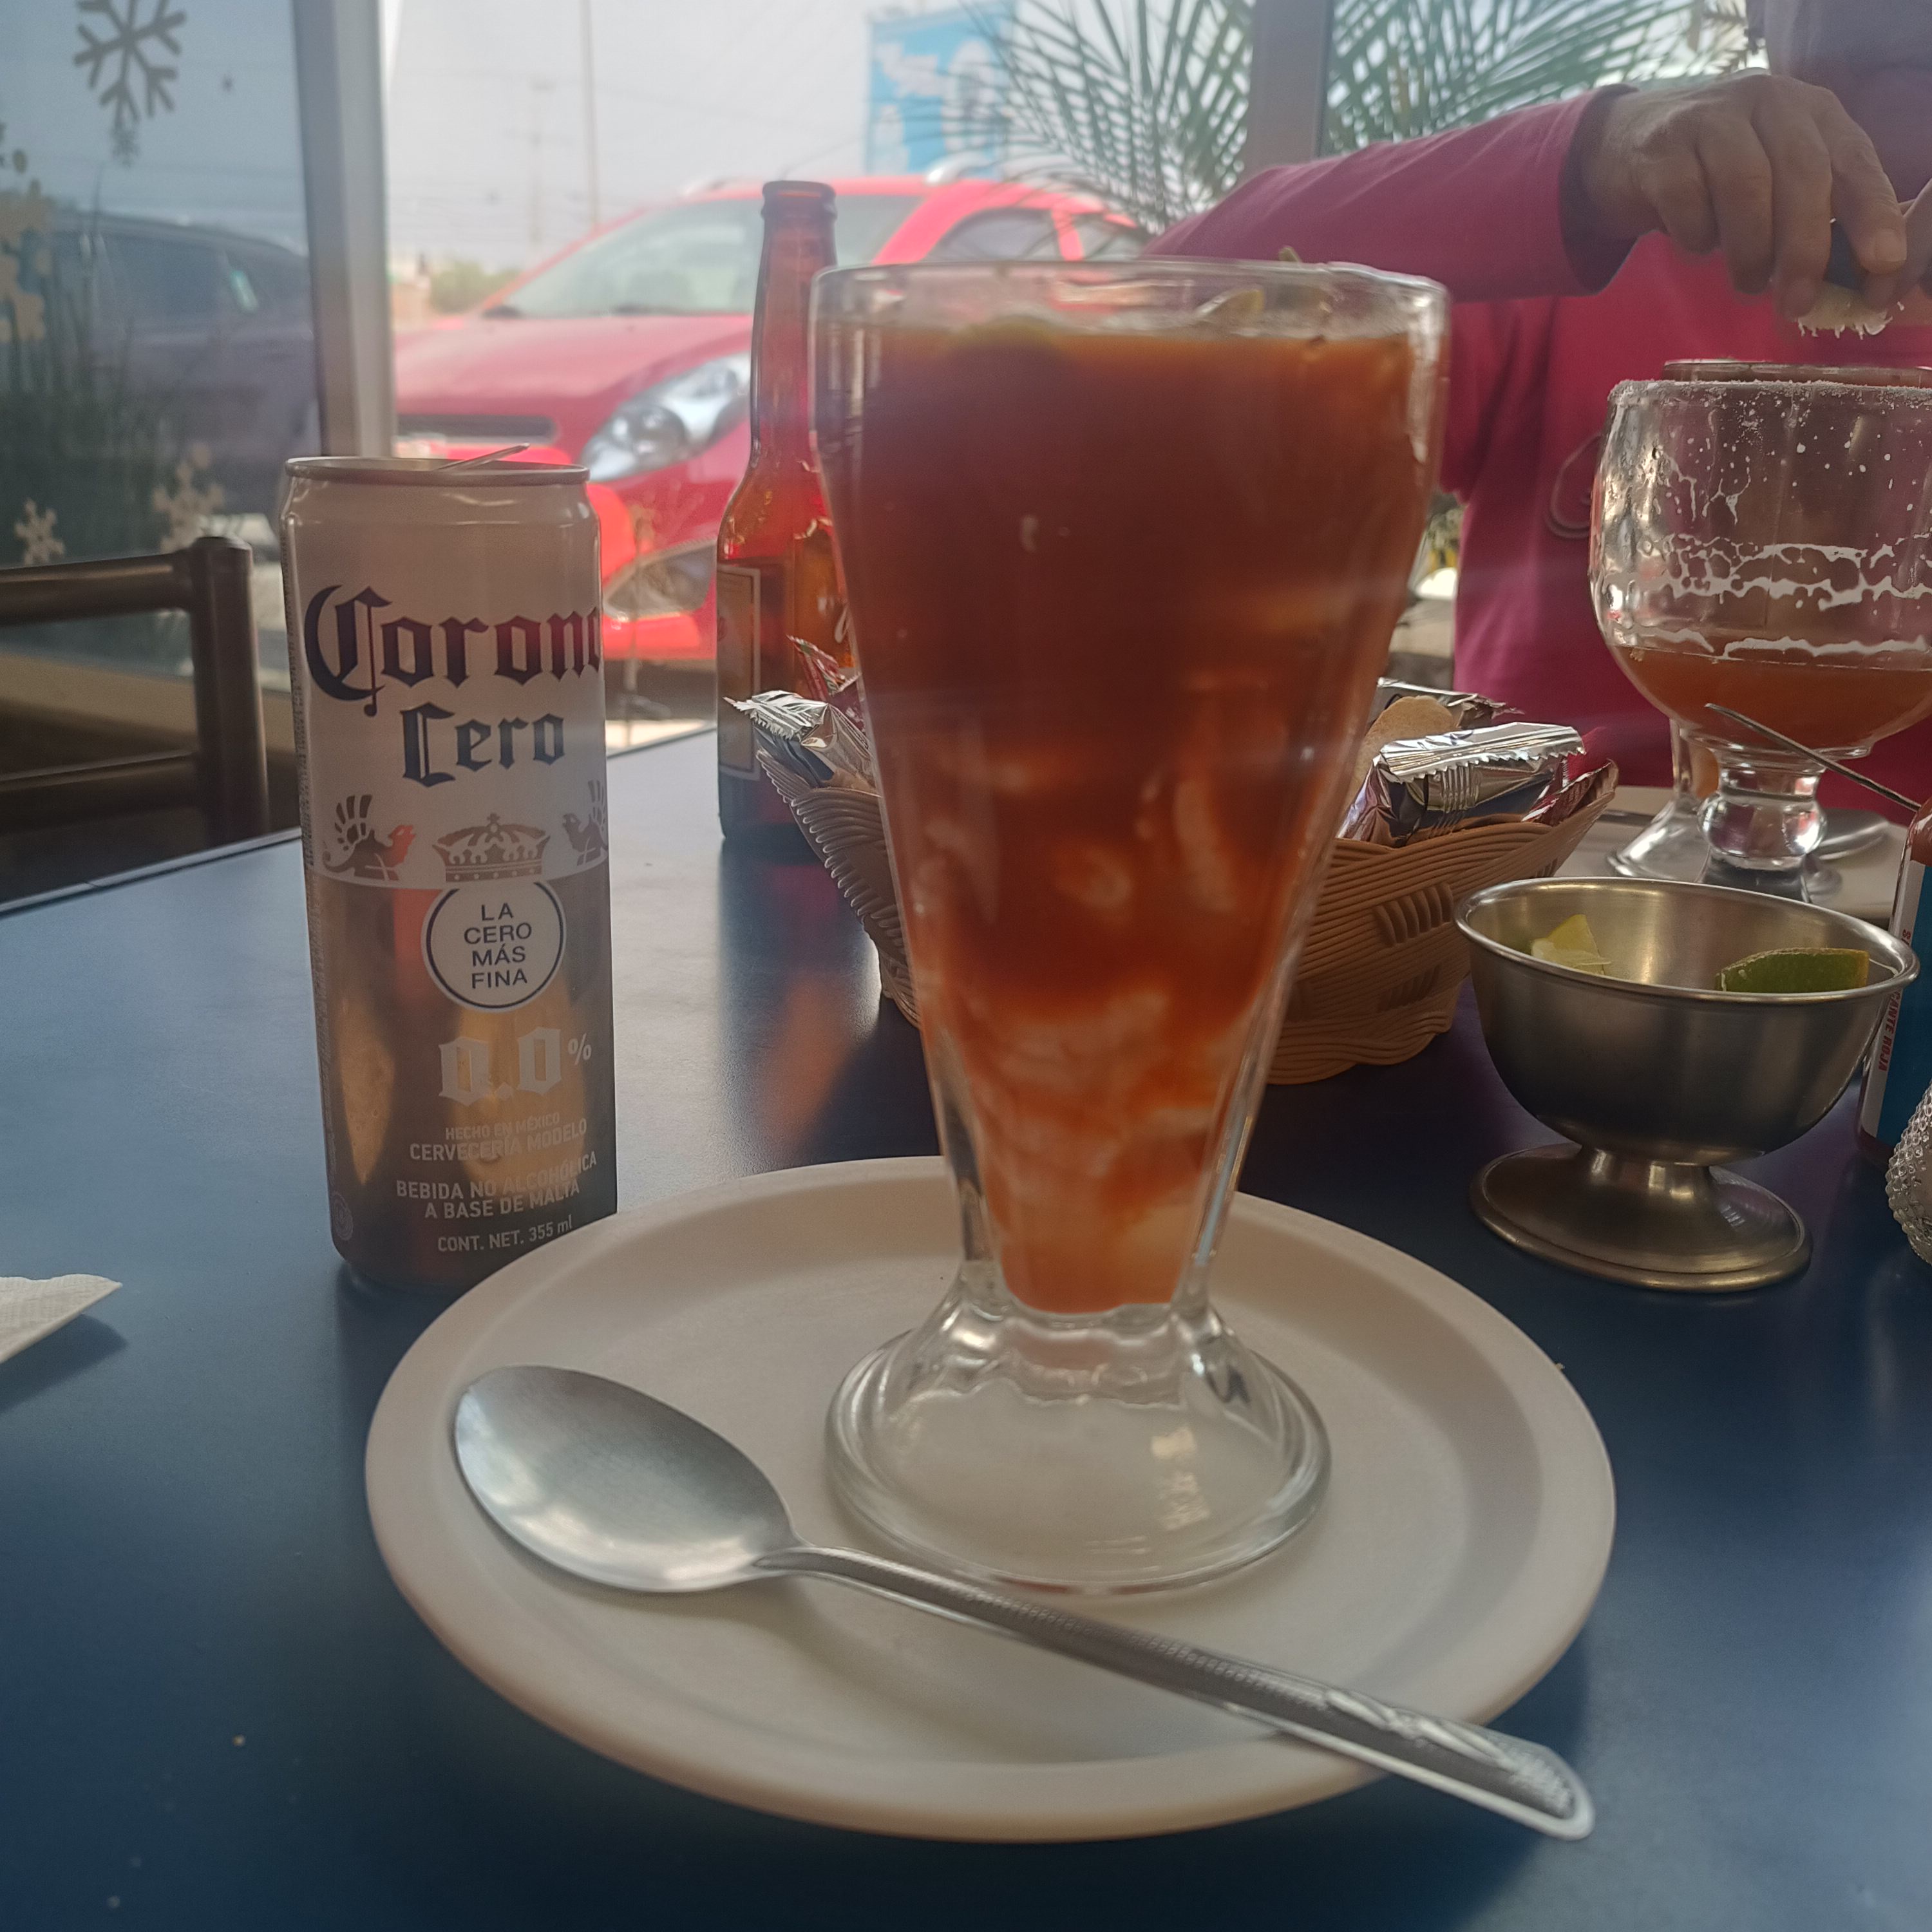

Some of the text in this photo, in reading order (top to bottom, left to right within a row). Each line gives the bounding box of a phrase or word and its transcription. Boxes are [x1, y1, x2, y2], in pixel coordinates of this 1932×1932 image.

[400, 702, 565, 788] Cero
[481, 903, 514, 921] LA
[464, 922, 532, 944] CERO
[472, 943, 526, 967] MÁS
[471, 968, 528, 989] FINA
[1879, 989, 1900, 1072] CANTE ROJA
[410, 1117, 587, 1161] CERVECERÍA MODELO
[446, 1112, 560, 1141] HECHO EN MÉXICO
[396, 1150, 597, 1200] BEBIDA NO ALCOHÓLICA
[425, 1181, 580, 1219] A BASE DE MALTA
[437, 1214, 573, 1252] CONT. NET. 355 ml
